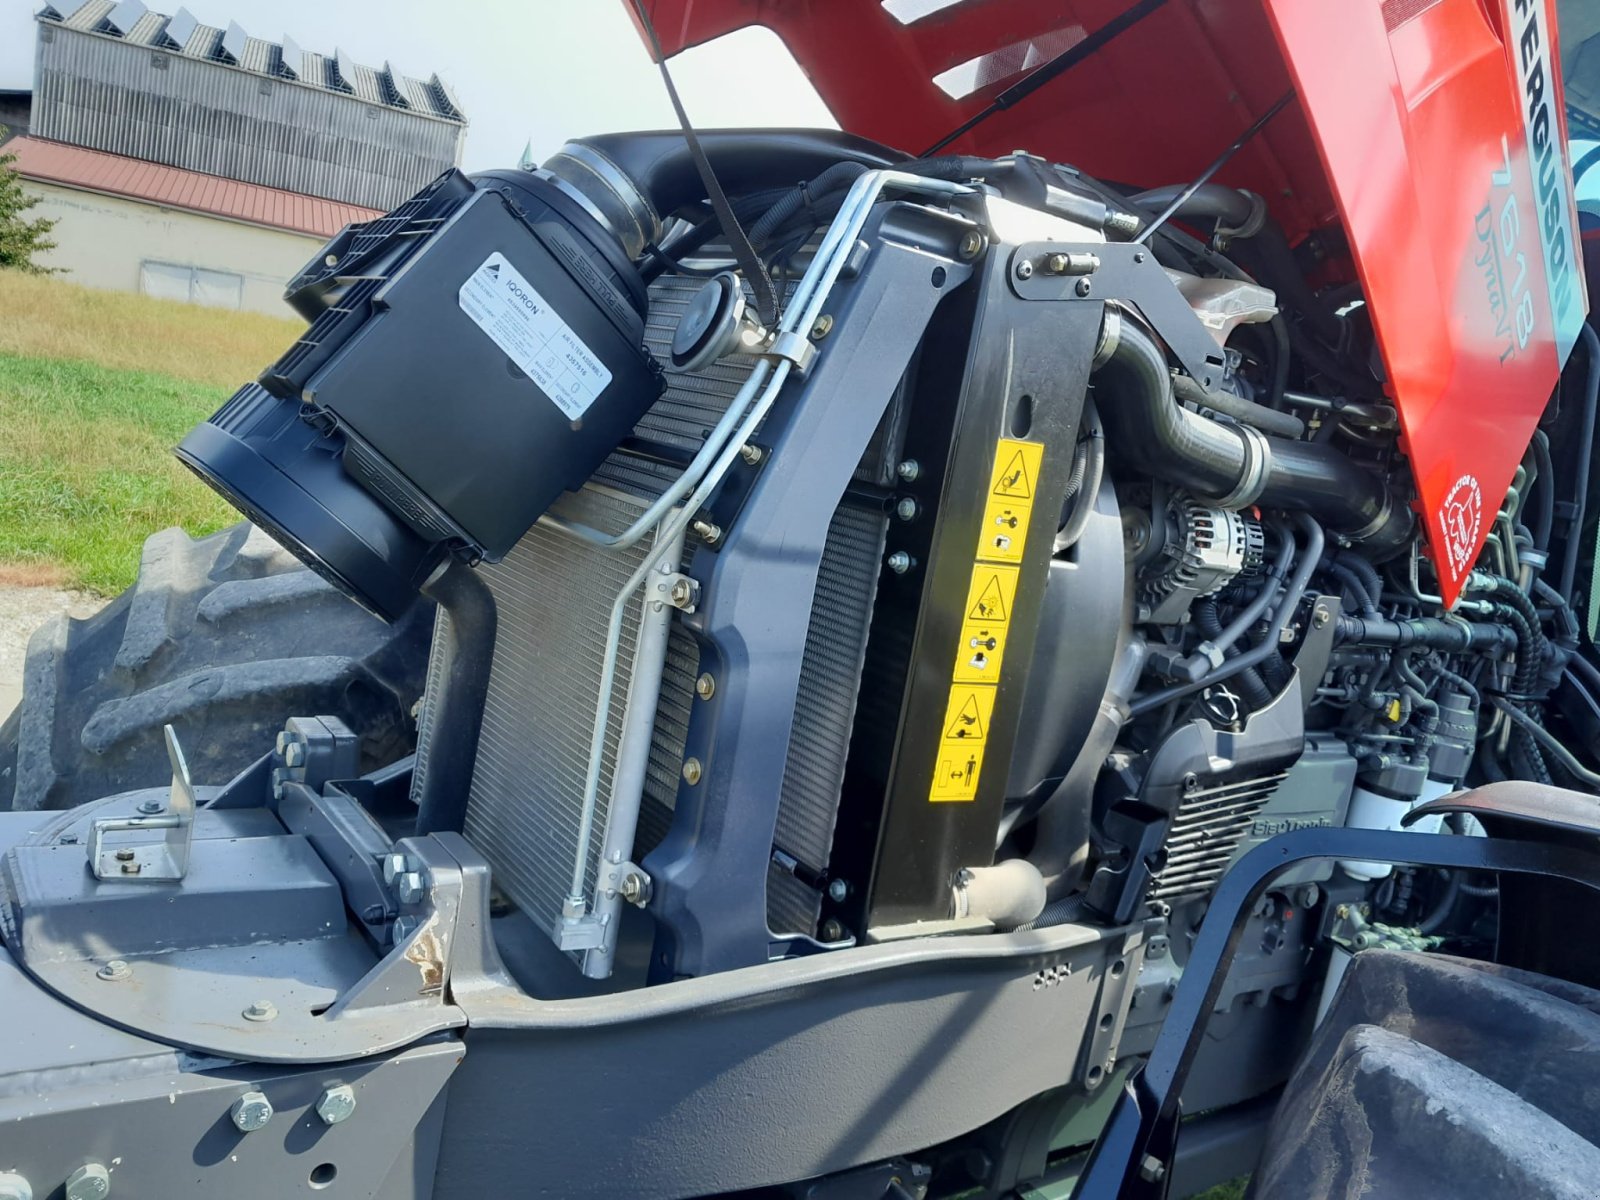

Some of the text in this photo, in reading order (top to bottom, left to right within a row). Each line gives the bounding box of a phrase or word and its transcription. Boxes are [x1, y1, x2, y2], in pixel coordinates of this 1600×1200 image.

[1491, 131, 1534, 350] 7618
[504, 278, 540, 315] IQORON
[573, 257, 616, 306] PULL HERE
[1444, 475, 1470, 508] TRACTOR
